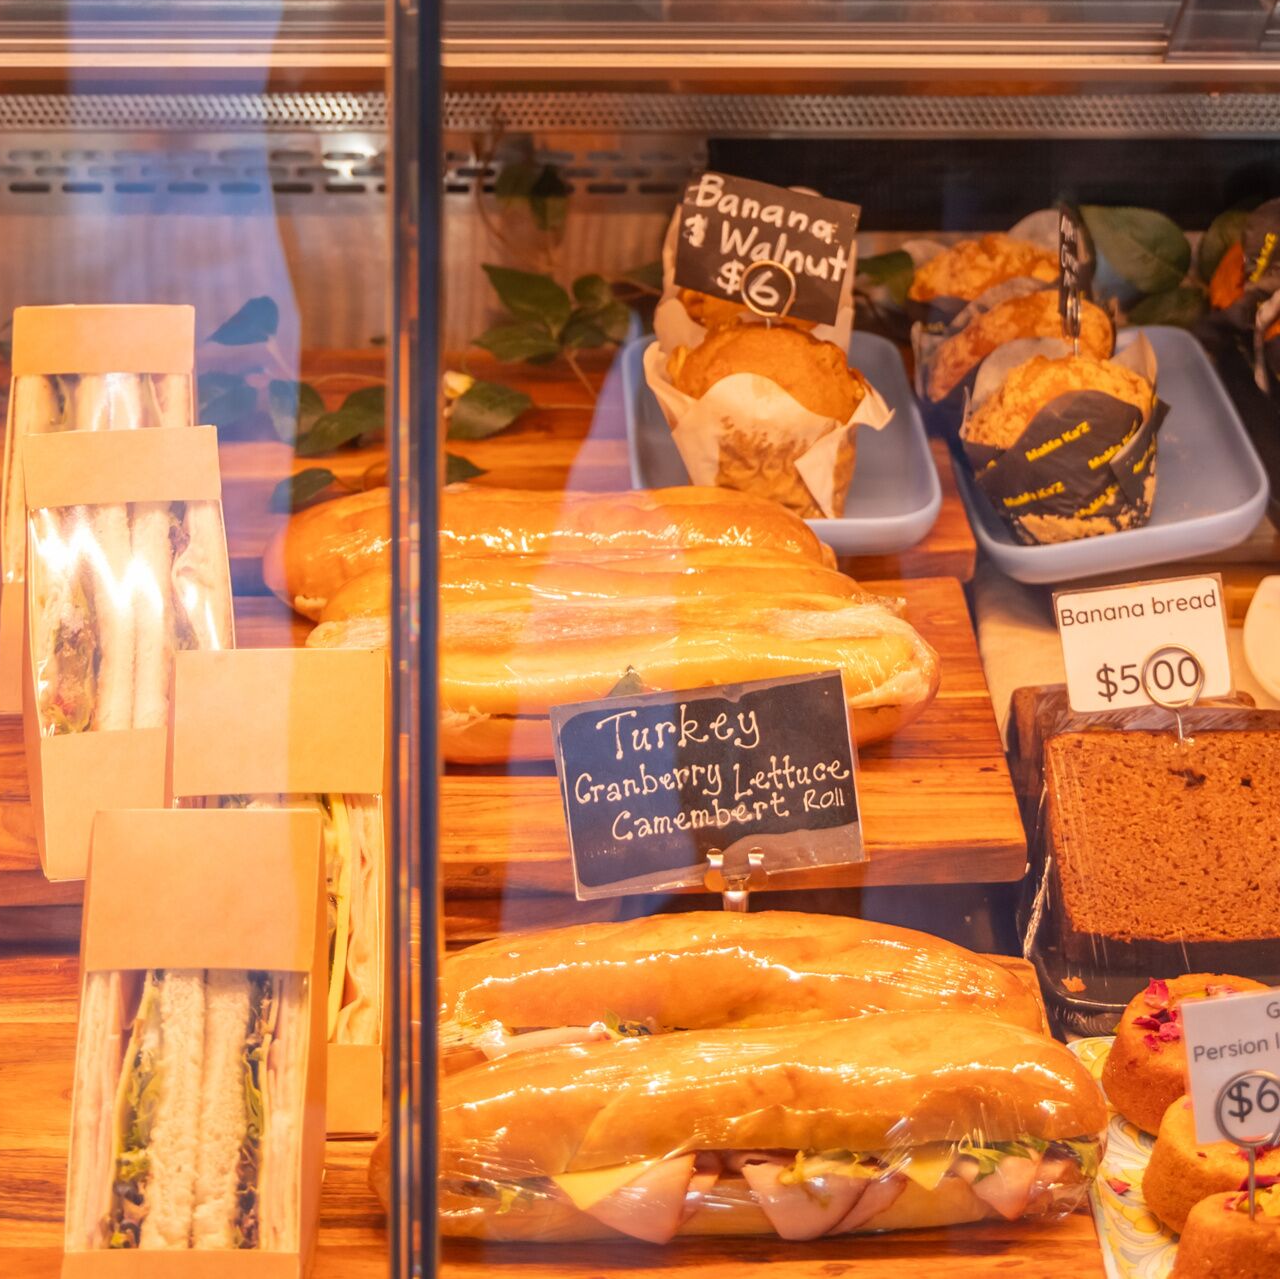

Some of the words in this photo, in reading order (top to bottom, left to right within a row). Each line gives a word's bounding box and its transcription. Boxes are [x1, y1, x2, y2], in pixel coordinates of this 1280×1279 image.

[695, 173, 834, 245] Banana
[720, 220, 848, 282] Walnut
[716, 259, 780, 307] $6
[1060, 603, 1145, 626] Banana
[1151, 589, 1217, 615] bread
[1096, 656, 1200, 702] $500
[595, 703, 761, 760] Turkey
[575, 763, 722, 804] Cranberry
[732, 754, 850, 801] Lettuce
[612, 794, 790, 841] Camembert
[1193, 1038, 1269, 1062] Persion
